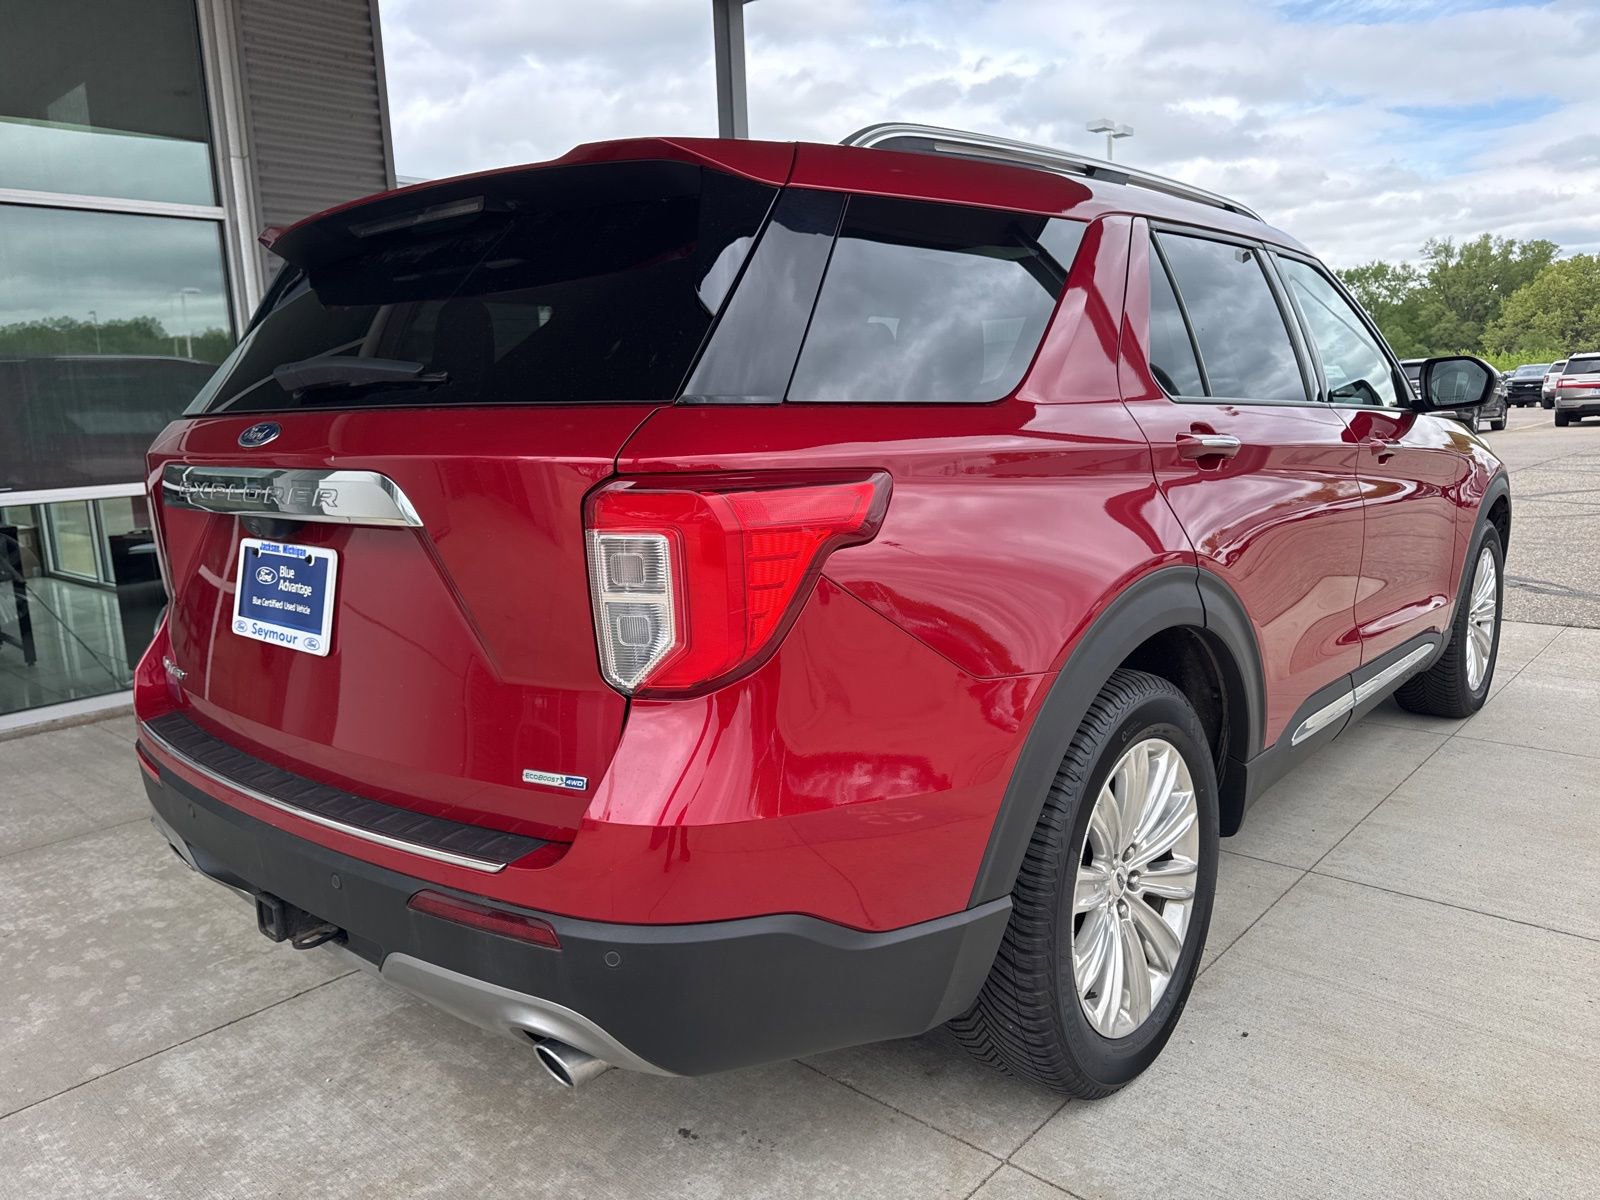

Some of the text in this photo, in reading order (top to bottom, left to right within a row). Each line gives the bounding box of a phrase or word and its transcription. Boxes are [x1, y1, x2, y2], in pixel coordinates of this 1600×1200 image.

[179, 480, 338, 508] EXPLORER
[282, 544, 307, 557] Michigan
[279, 565, 295, 579] Blue
[278, 579, 312, 597] Advantage
[252, 596, 311, 615] Blue Certified Used Vehicle
[251, 622, 298, 645] Seymour
[565, 779, 583, 787] 4WD
